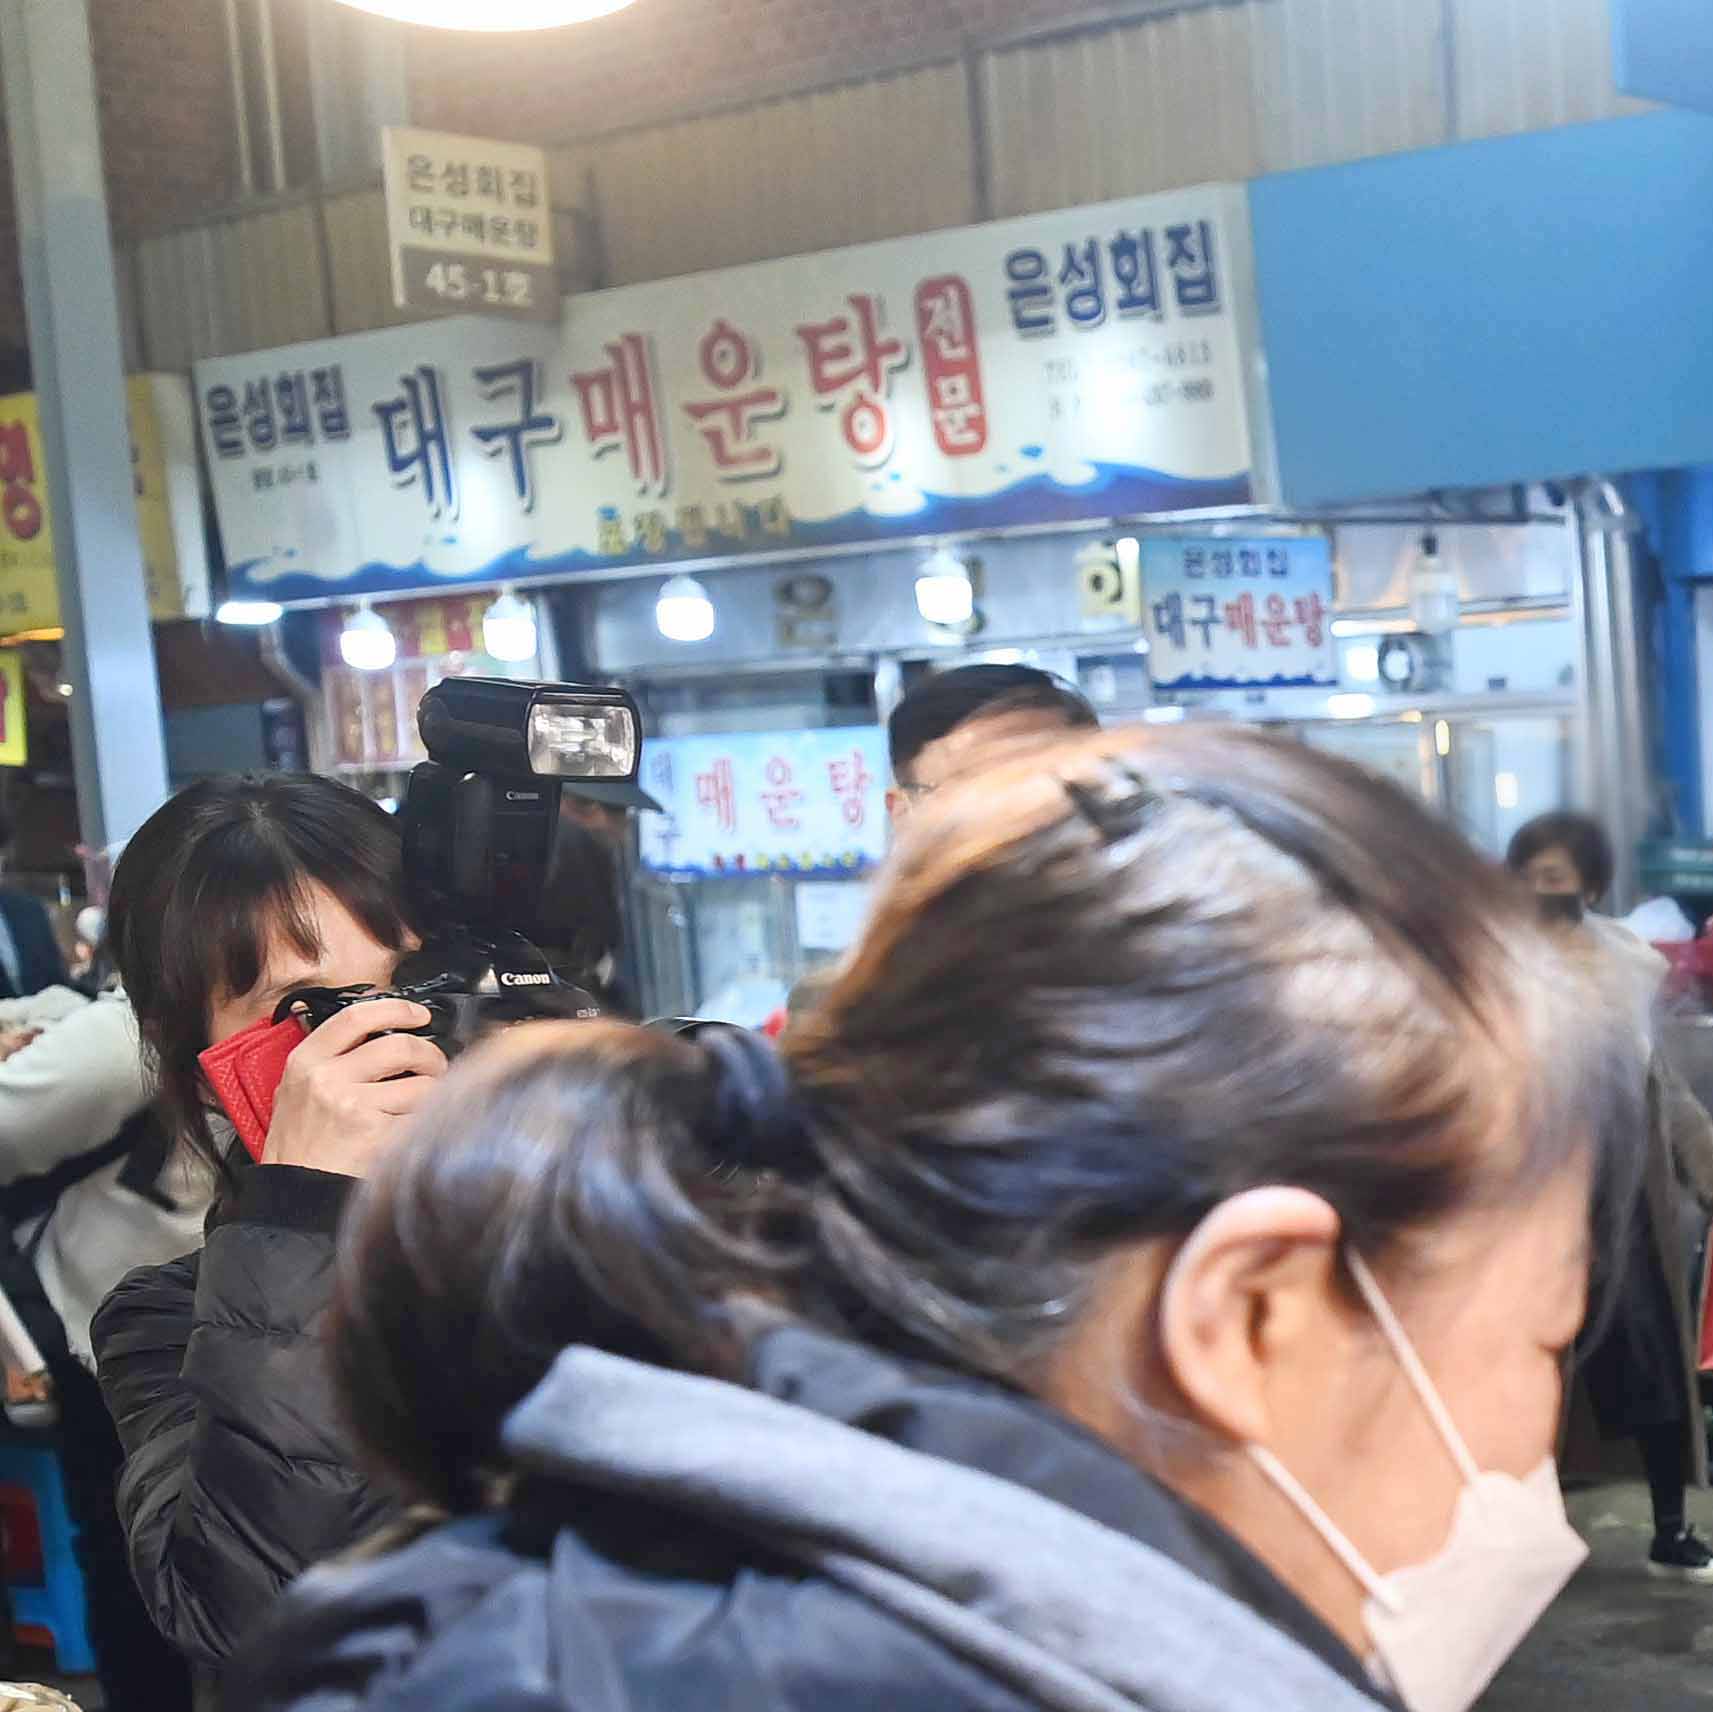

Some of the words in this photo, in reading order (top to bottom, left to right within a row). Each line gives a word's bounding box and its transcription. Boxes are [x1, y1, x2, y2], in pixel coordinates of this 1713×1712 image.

[406, 153, 538, 209] 은성회집
[1004, 220, 1219, 334] 은성회집
[205, 364, 350, 458] 은성회집
[501, 972, 551, 986] Canon
